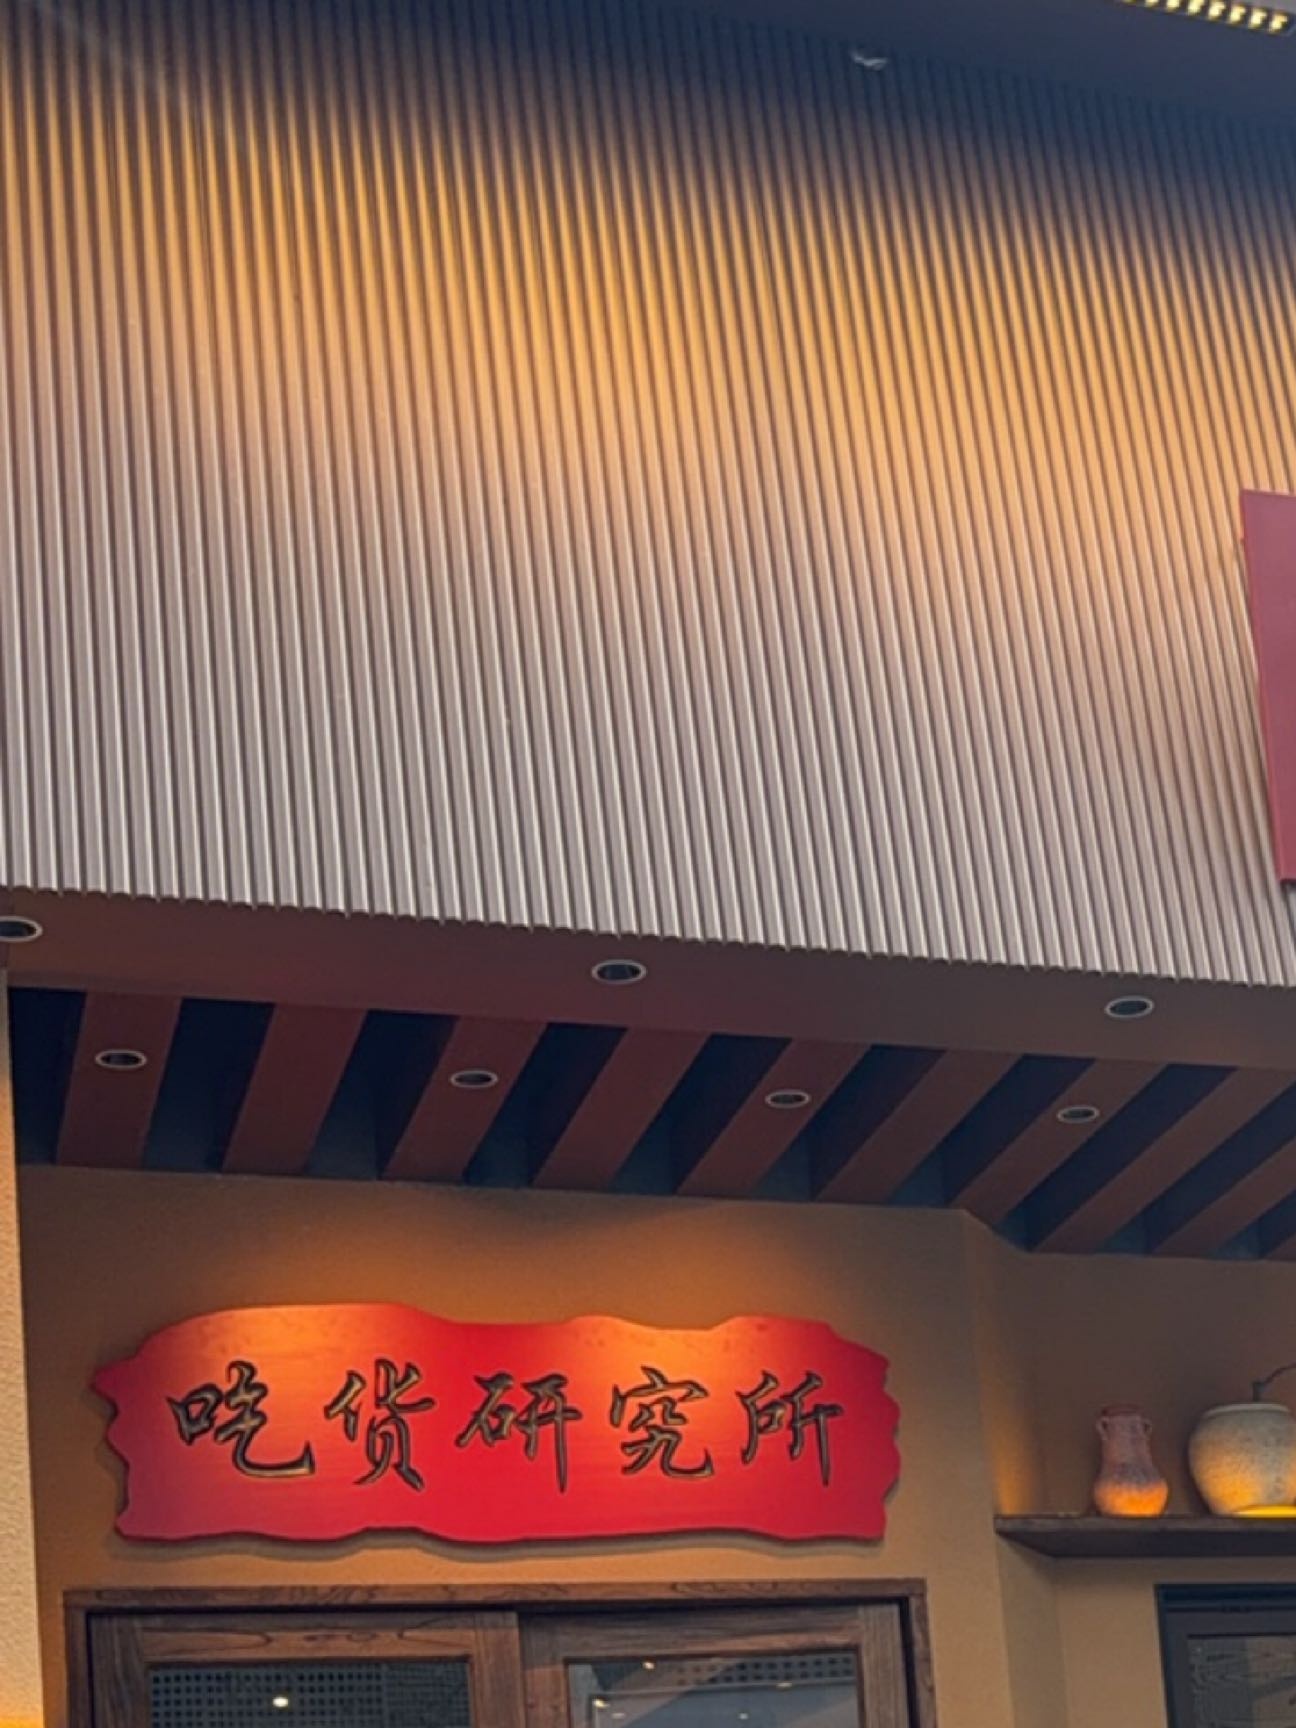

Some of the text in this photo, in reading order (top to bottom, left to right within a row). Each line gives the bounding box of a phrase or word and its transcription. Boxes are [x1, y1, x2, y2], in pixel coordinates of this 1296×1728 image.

[166, 1358, 844, 1494] 吃货研究所
